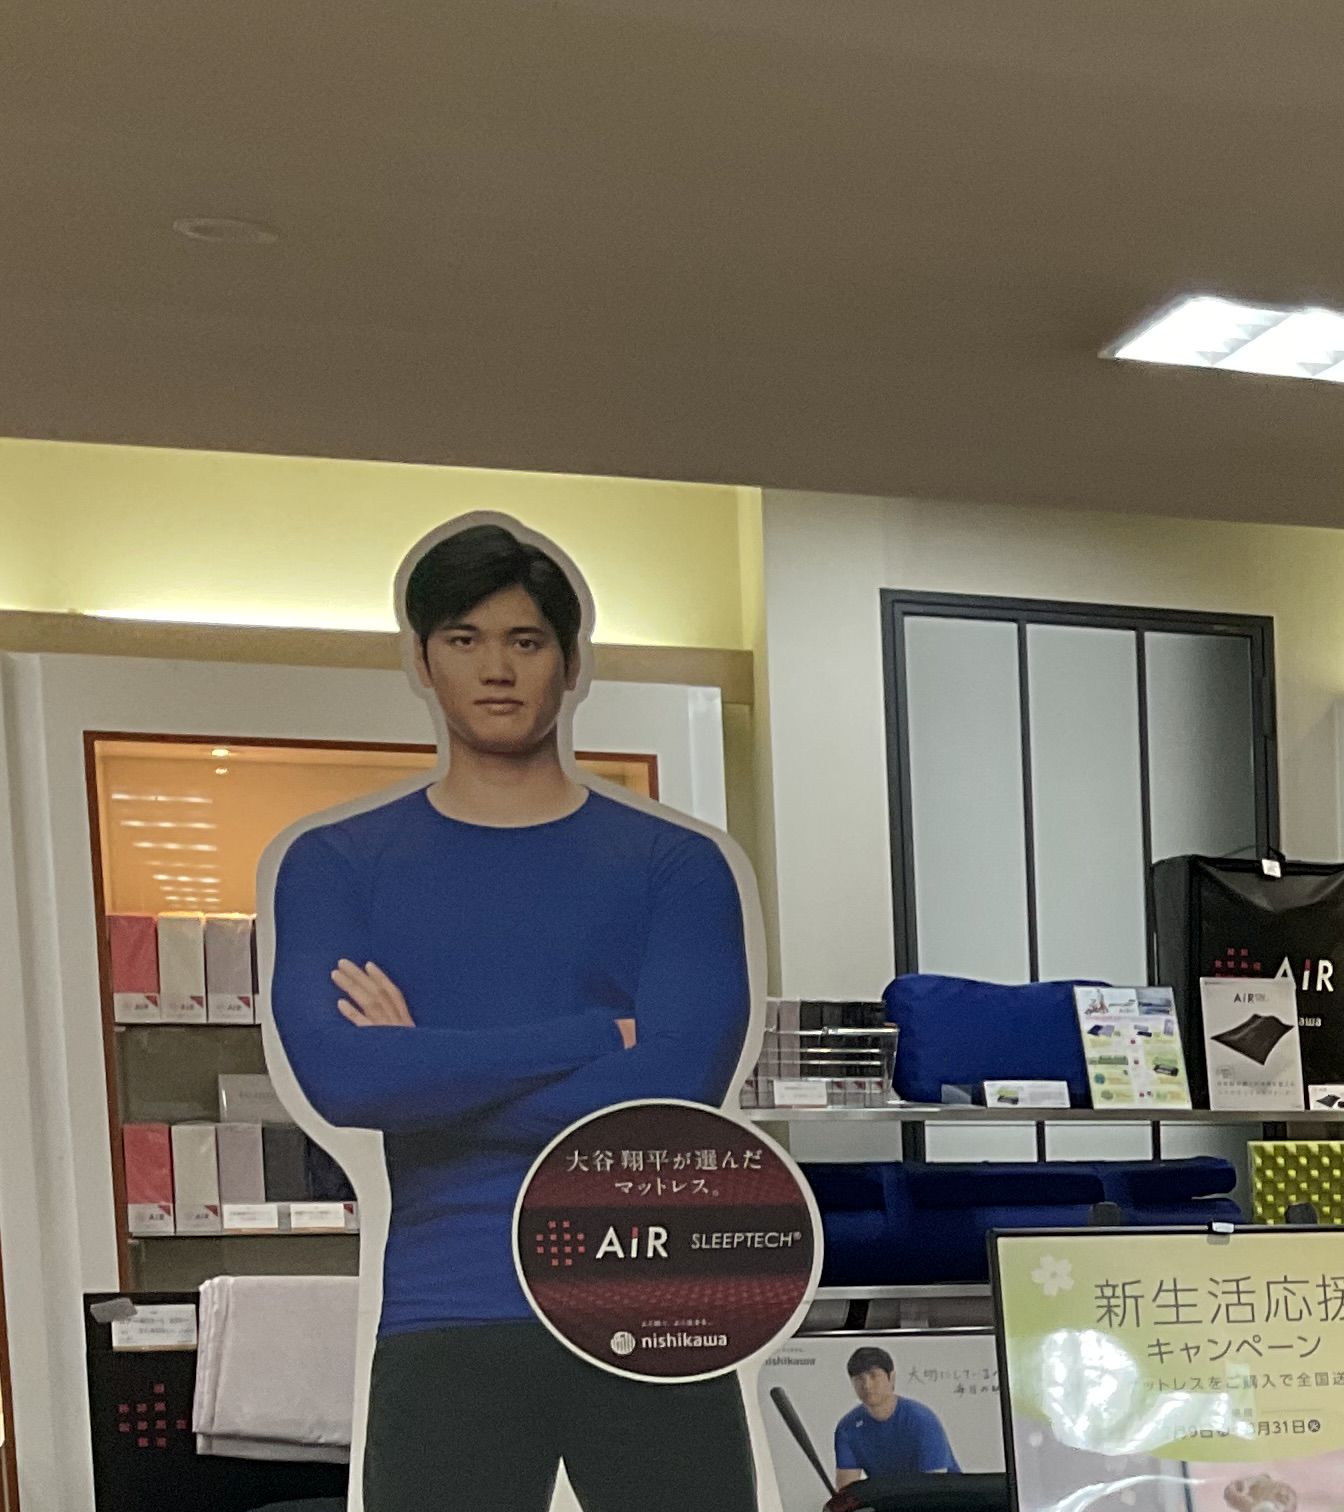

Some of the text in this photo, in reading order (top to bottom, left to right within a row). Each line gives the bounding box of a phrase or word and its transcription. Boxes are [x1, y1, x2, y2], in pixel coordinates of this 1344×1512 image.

[1274, 956, 1334, 992] AiR
[565, 1149, 763, 1173] 大谷翔平が選んだ
[614, 1178, 720, 1197] マットレス。
[595, 1225, 669, 1259] AiR
[641, 1332, 728, 1348] nishikawa
[1147, 1334, 1322, 1365] キャンペーン
